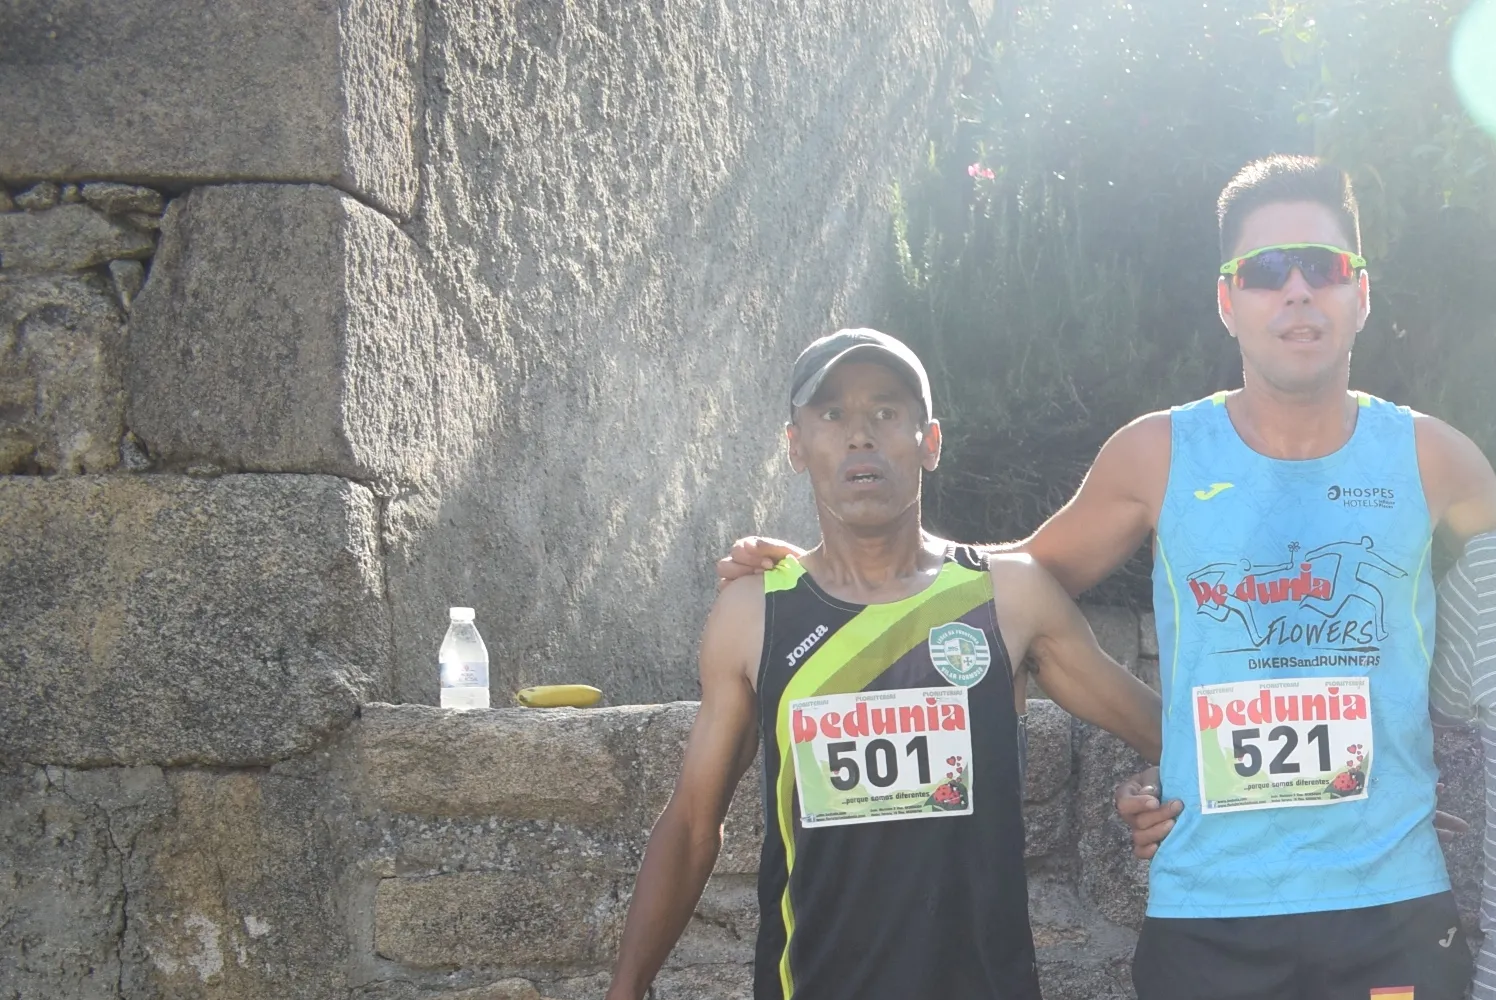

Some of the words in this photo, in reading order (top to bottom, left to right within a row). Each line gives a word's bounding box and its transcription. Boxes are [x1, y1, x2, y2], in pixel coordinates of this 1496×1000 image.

[1342, 487, 1395, 499] HOSPES
[1343, 499, 1379, 508] HOTELS
[1189, 563, 1332, 606] bedunia
[1265, 615, 1374, 646] FLOWERS
[1248, 655, 1381, 670] BIKERSandRUNNERS
[792, 697, 967, 744] bedunia
[1196, 686, 1368, 732] bedunia
[826, 735, 932, 792] 501
[1231, 724, 1332, 778] 521
[870, 794, 894, 802] somos
[895, 790, 931, 800] diferentes
[1271, 780, 1294, 788] somos
[1295, 778, 1330, 787] diferentes
